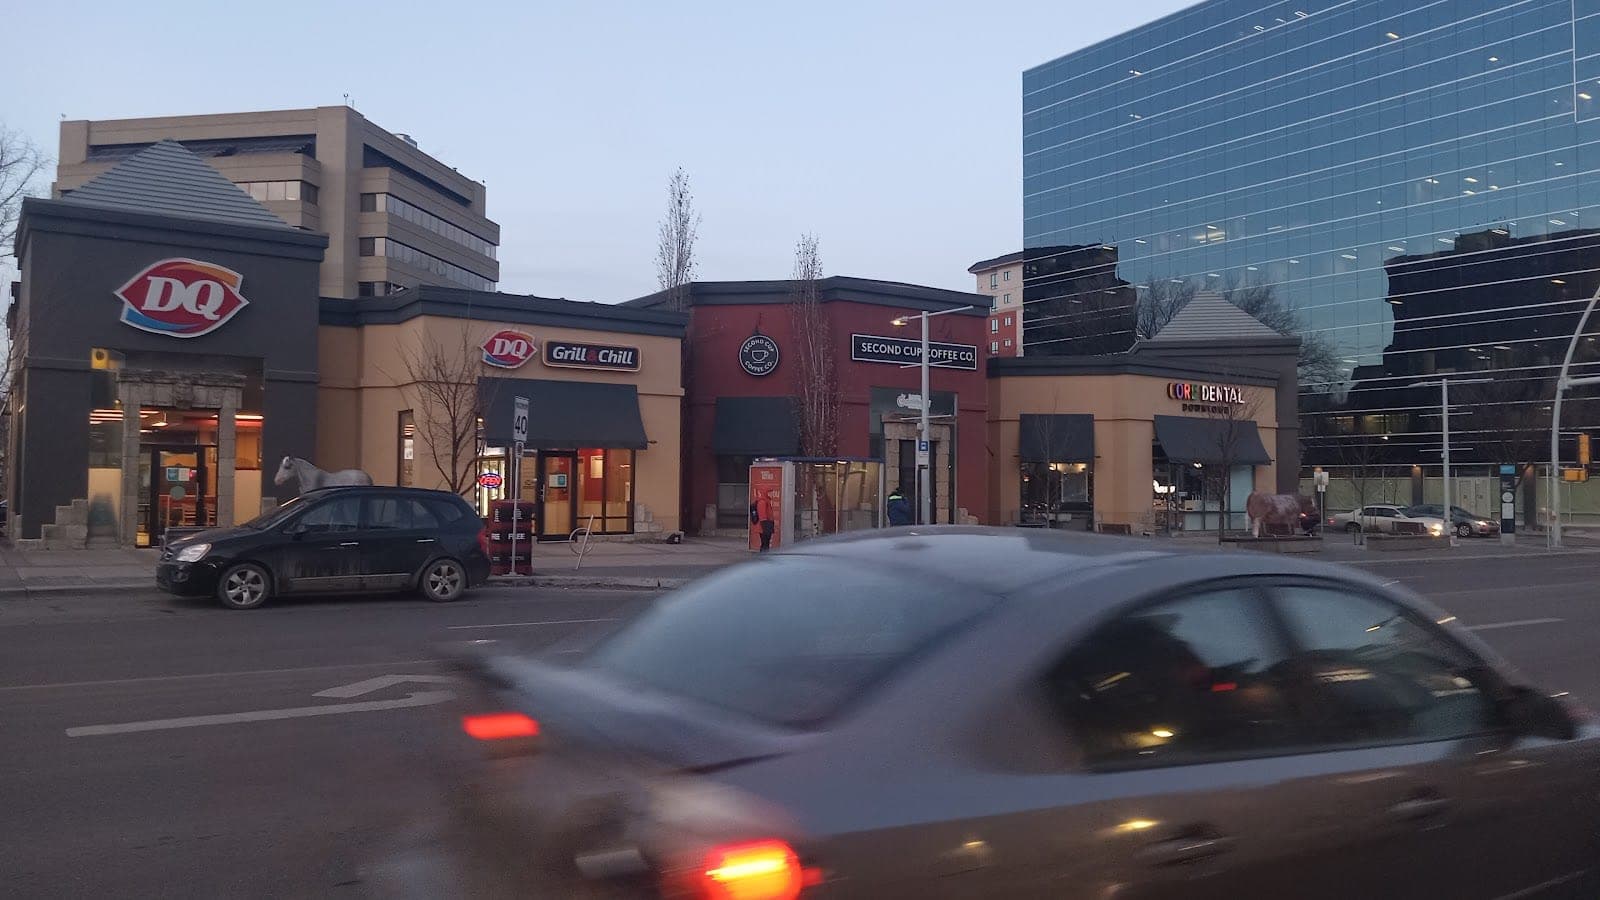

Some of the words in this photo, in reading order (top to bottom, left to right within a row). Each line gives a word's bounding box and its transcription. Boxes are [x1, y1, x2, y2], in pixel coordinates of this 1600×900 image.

[141, 276, 225, 321] DQ
[491, 338, 528, 360] DQ
[552, 346, 586, 362] Grill
[598, 349, 633, 365] Chill
[861, 342, 902, 356] SECOND
[959, 351, 975, 362] CO.
[1167, 383, 1198, 401] CORE
[1201, 384, 1246, 404] DENTAL
[514, 415, 528, 435] 40
[479, 474, 502, 487] OPEN
